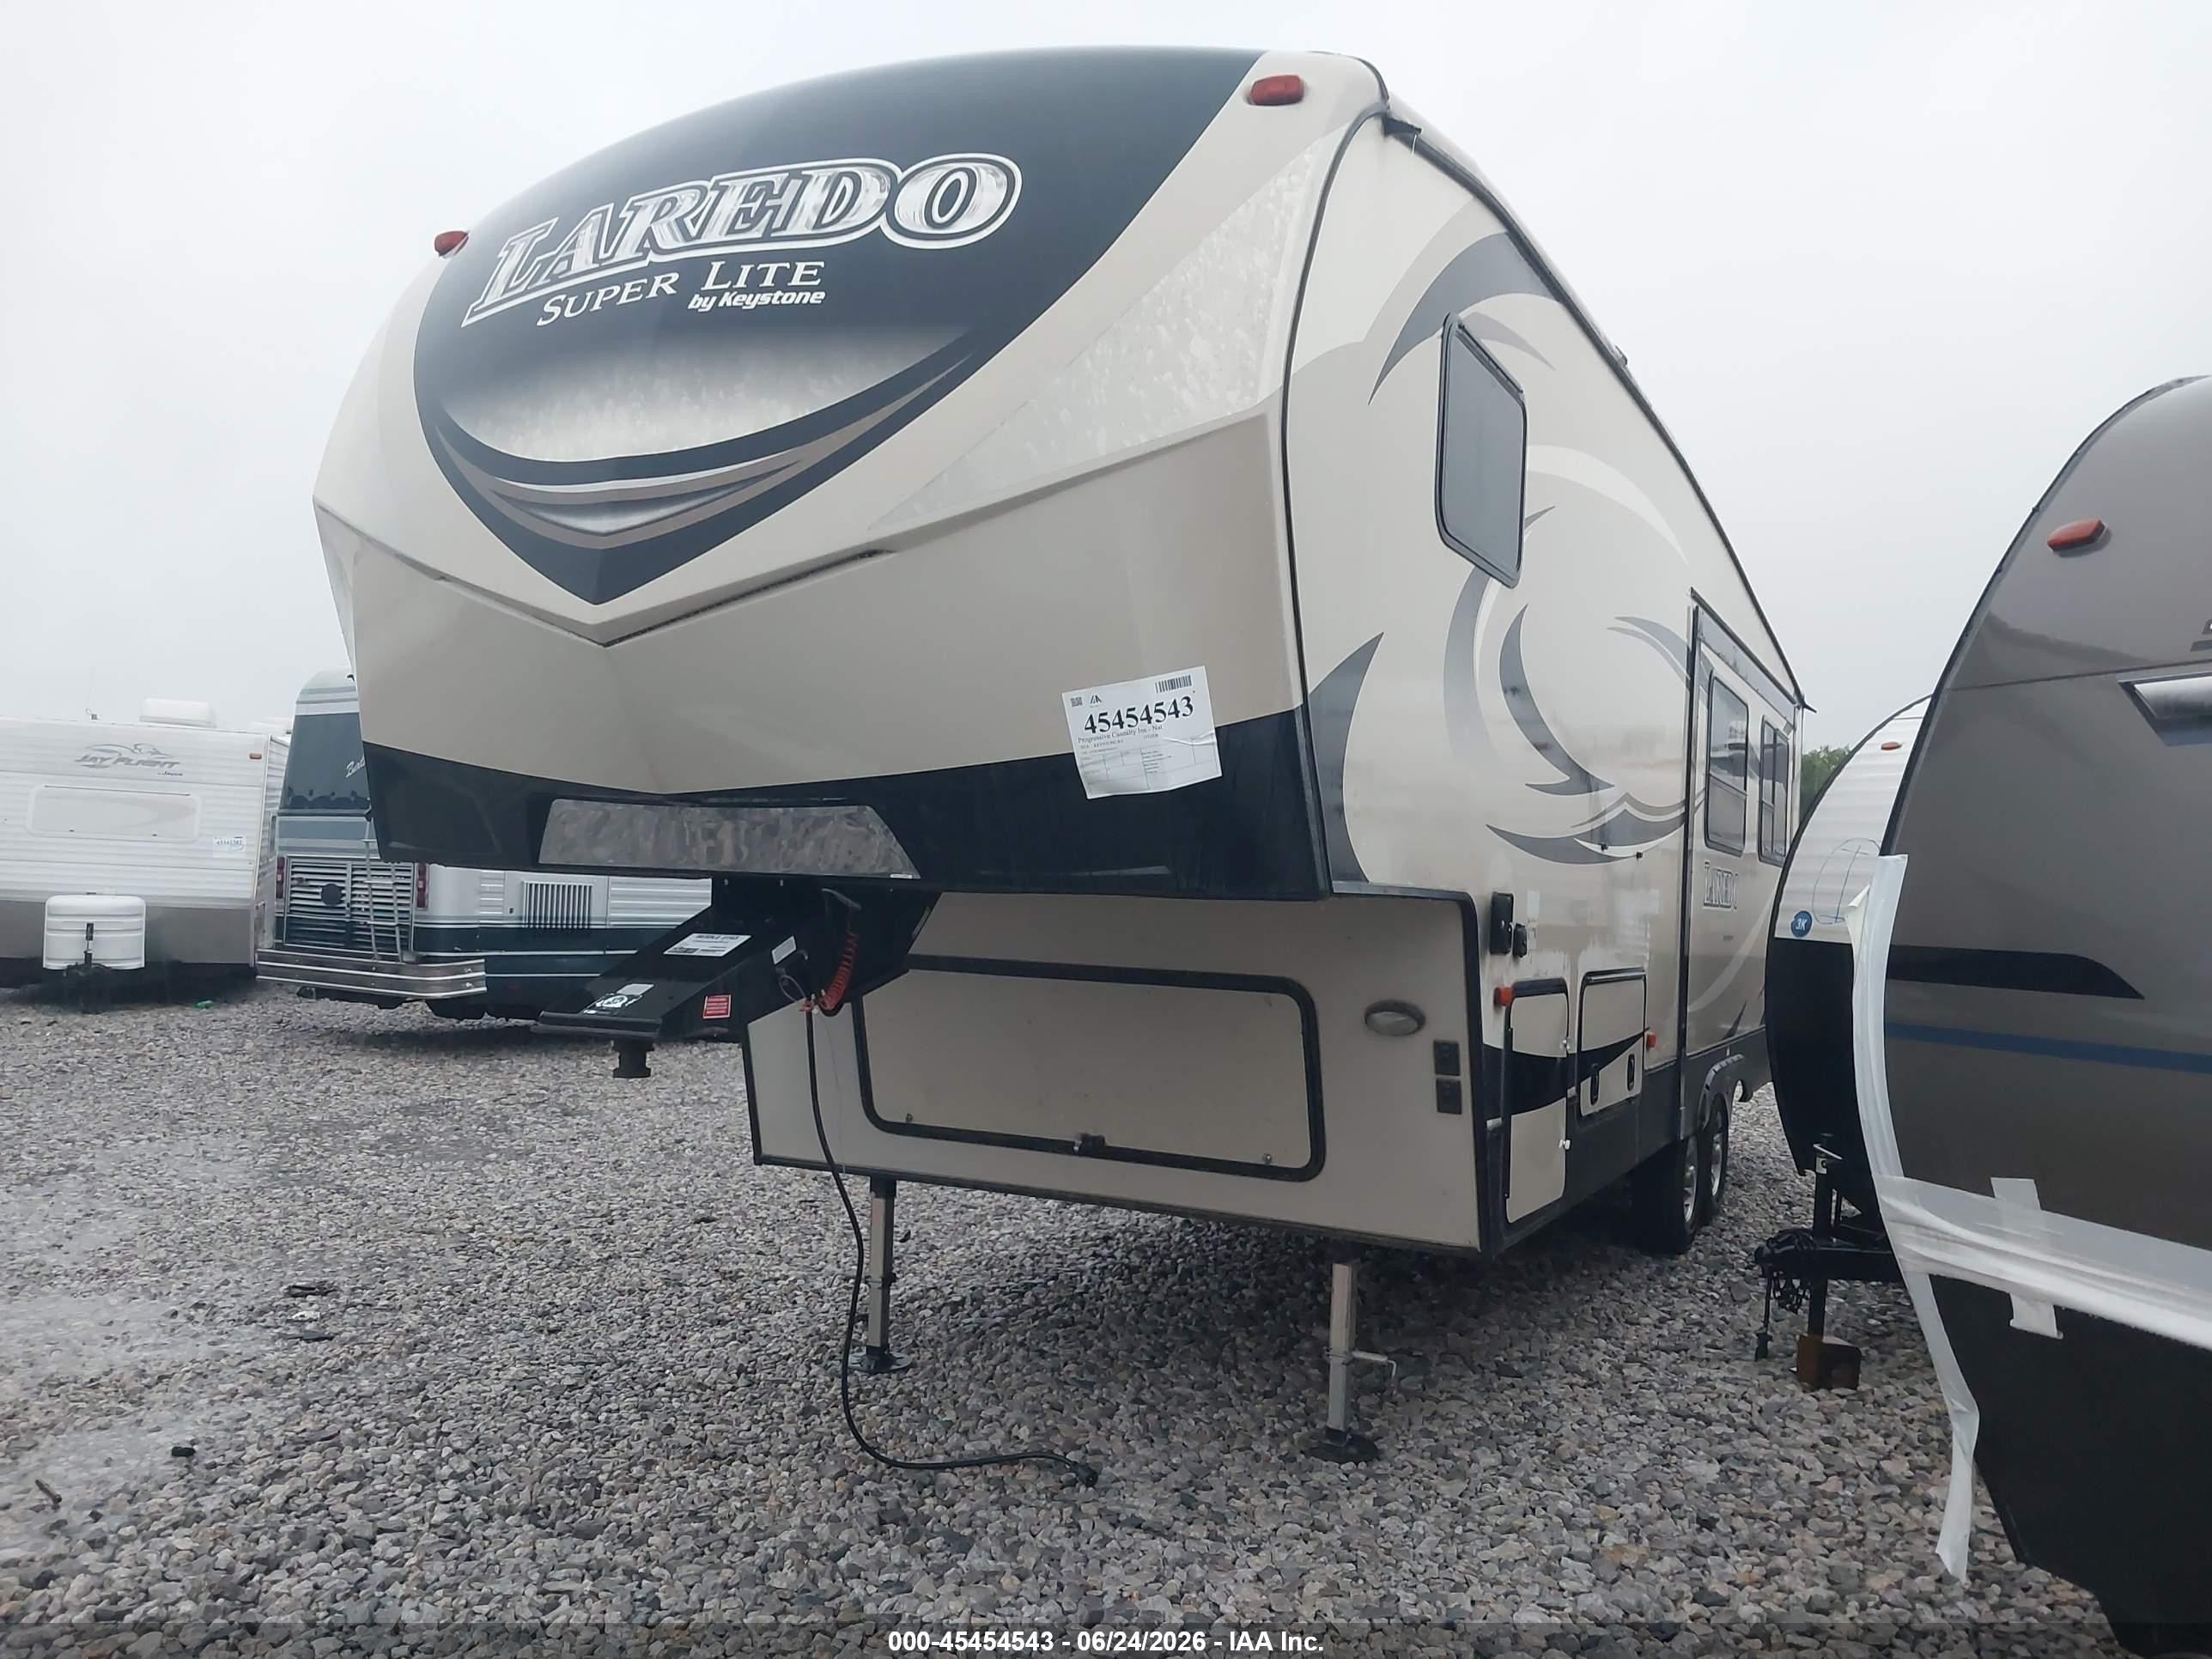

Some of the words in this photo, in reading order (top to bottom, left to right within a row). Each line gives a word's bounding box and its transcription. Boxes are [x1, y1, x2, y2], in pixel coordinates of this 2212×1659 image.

[460, 152, 1024, 328] LAREDO
[536, 271, 681, 327] SUPER
[700, 260, 825, 292] LITE
[688, 292, 718, 313] by
[718, 290, 827, 310] Keystone
[1084, 696, 1194, 734] 45454543
[1078, 733, 1111, 744] Progressive
